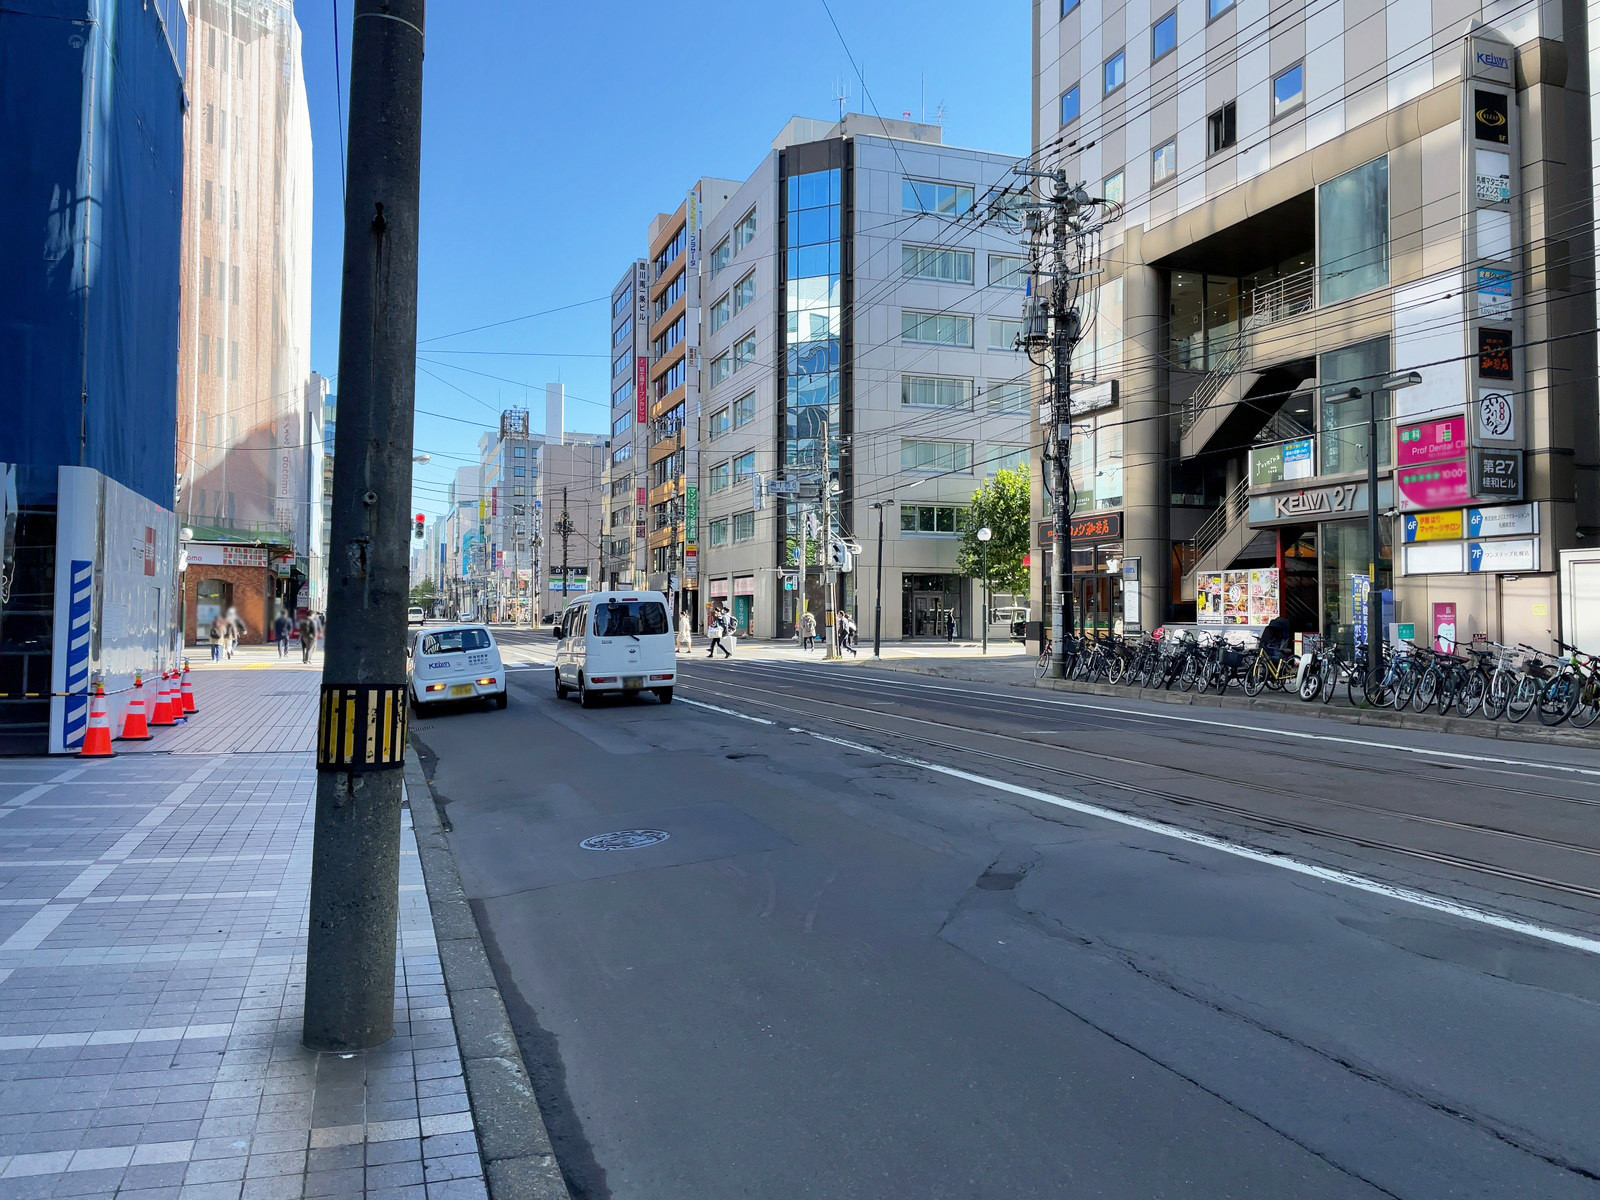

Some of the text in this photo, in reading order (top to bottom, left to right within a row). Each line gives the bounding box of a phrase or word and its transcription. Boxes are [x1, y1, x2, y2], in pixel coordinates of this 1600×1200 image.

[1411, 446, 1427, 455] Prof
[1428, 440, 1453, 452] Dental
[1483, 459, 1514, 474] 第27
[282, 456, 290, 495] docomo
[1482, 477, 1516, 489] 桂和ビル
[1334, 485, 1358, 512] 27
[1401, 501, 1409, 509] 7F
[1471, 515, 1481, 524] 6F
[1407, 522, 1417, 530] 6F
[1419, 523, 1460, 533] マッサージサロン
[1472, 549, 1481, 559] 7F
